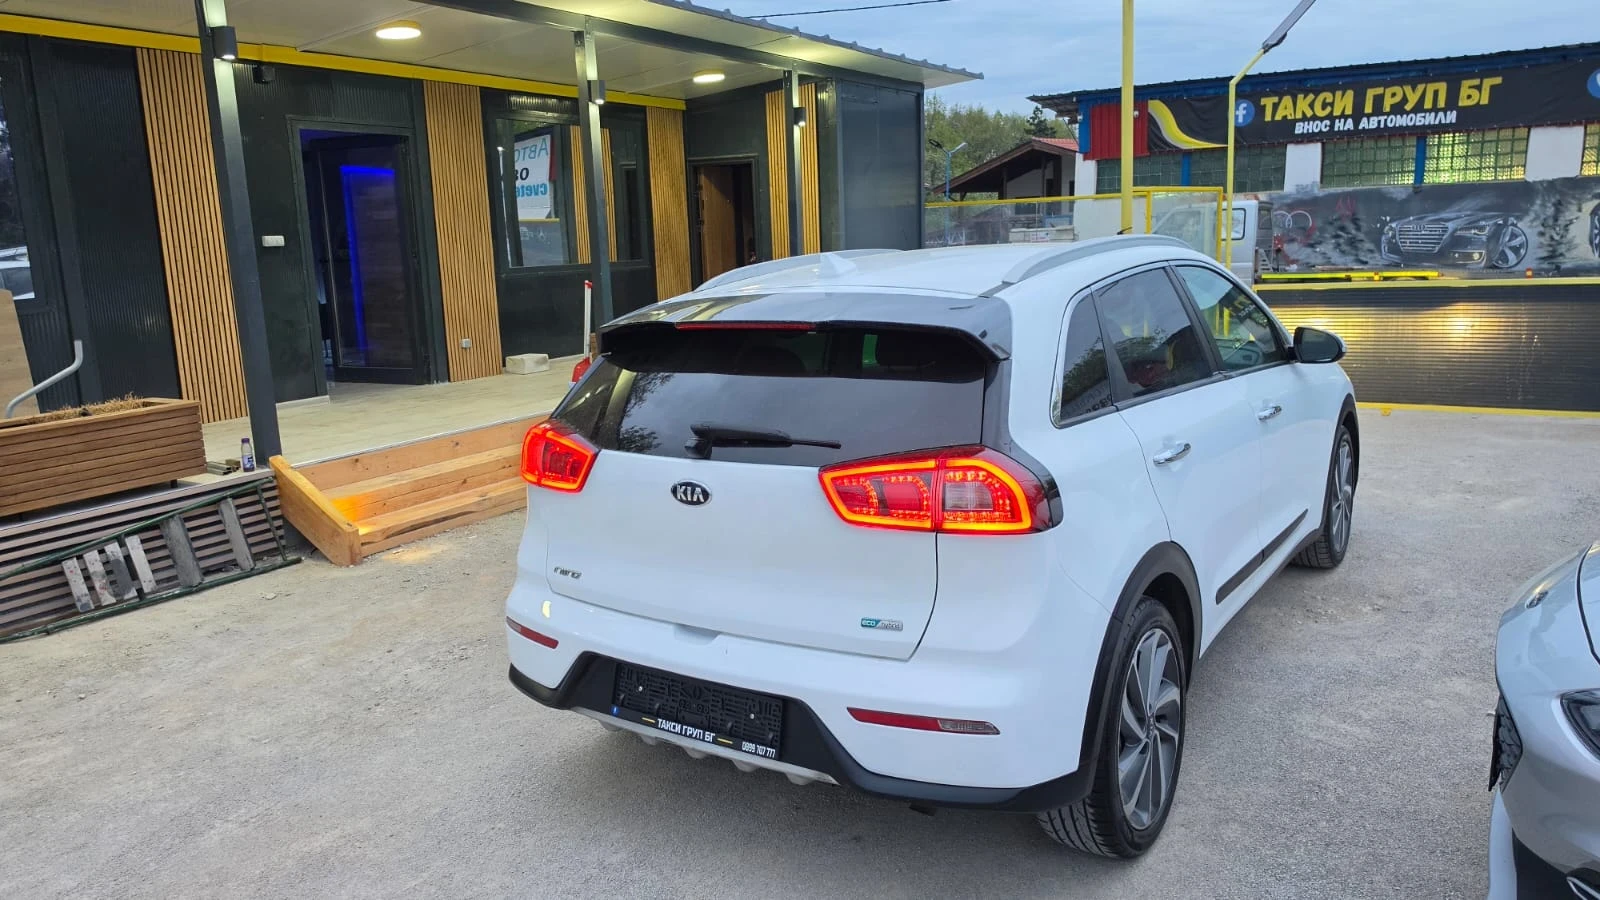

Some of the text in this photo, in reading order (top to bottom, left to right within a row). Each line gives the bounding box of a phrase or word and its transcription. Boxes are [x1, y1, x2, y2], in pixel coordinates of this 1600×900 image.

[1260, 76, 1503, 122] ТАКСИ ГРУП БГ
[1294, 110, 1457, 135] ВНОС НА АВТОМОБИЛИ
[676, 484, 705, 503] KIA
[657, 718, 716, 743] ТАКСИ ГРУП БГ
